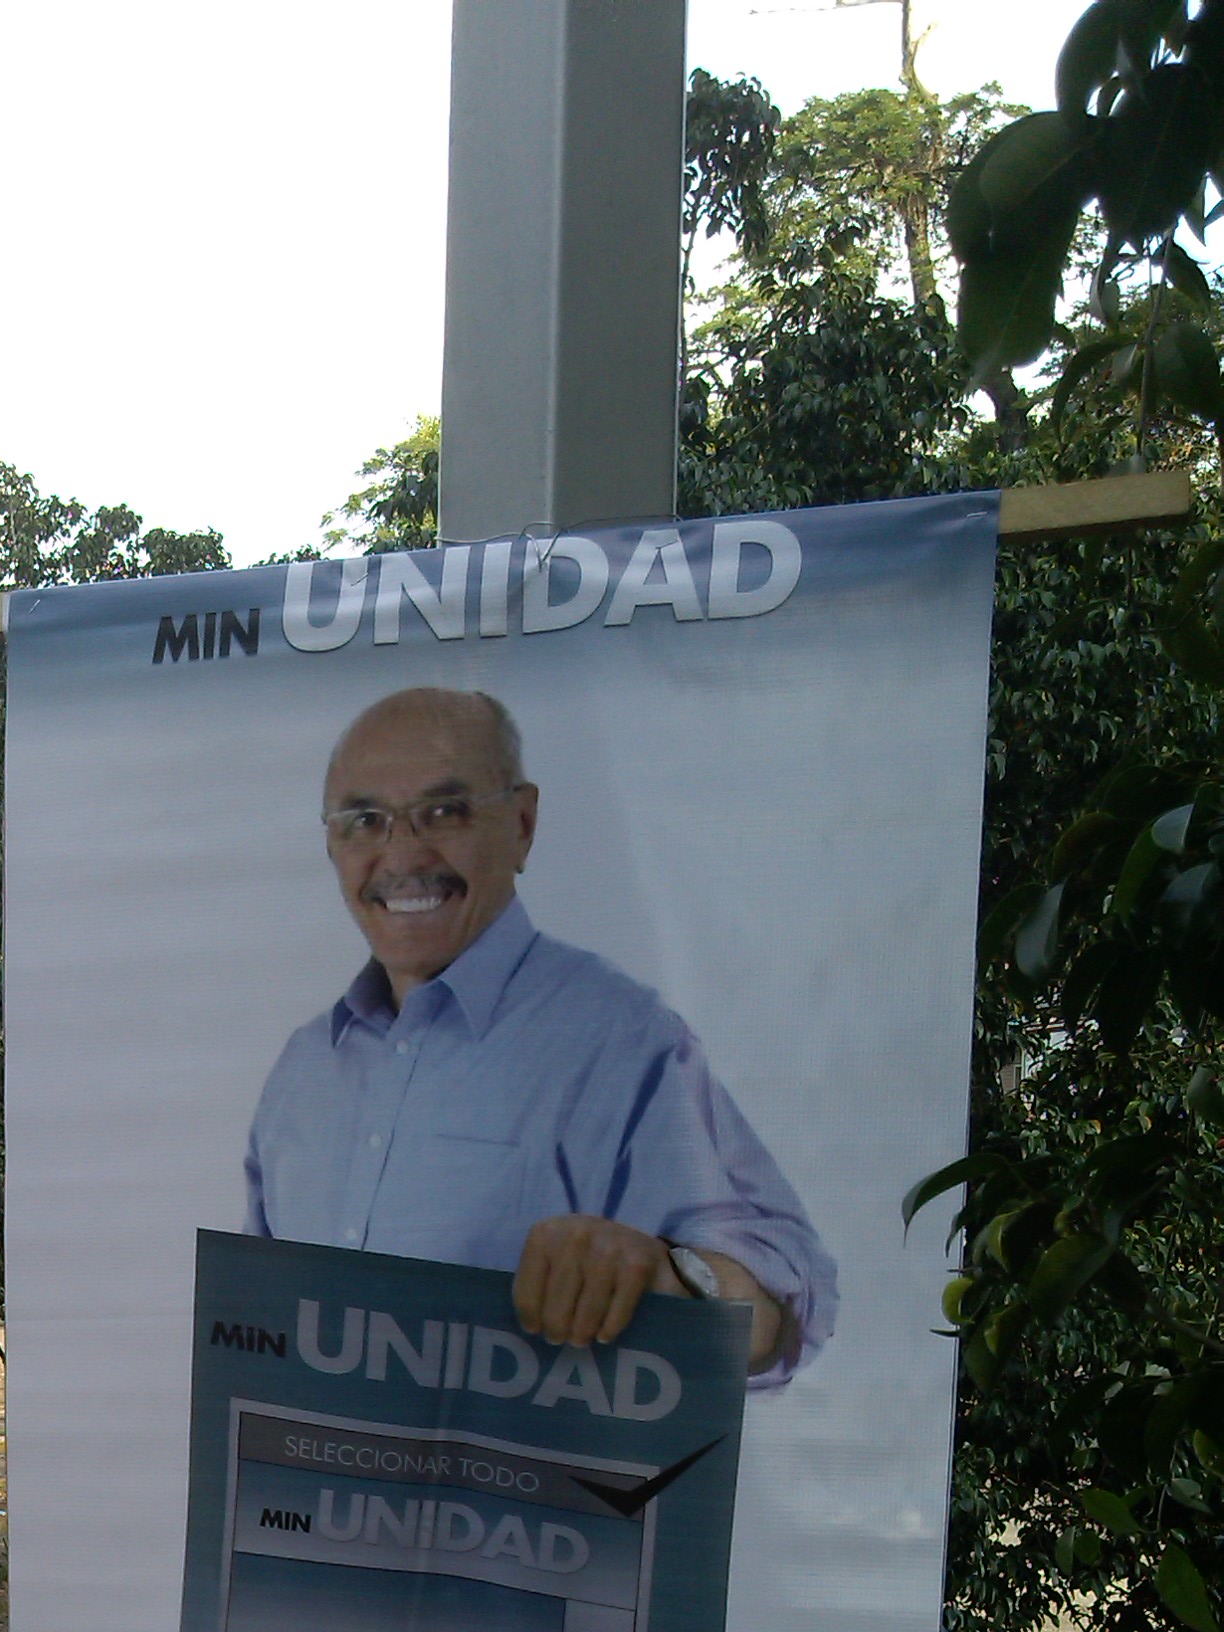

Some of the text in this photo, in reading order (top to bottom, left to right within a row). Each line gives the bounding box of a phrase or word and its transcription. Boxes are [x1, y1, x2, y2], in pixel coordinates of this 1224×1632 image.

[152, 519, 803, 665] MIN UNIDAD
[210, 1298, 682, 1423] MIN UNIDAD
[284, 1435, 540, 1493] SELECCIONAR TODO
[259, 1488, 591, 1575] MIN UNIDAD
